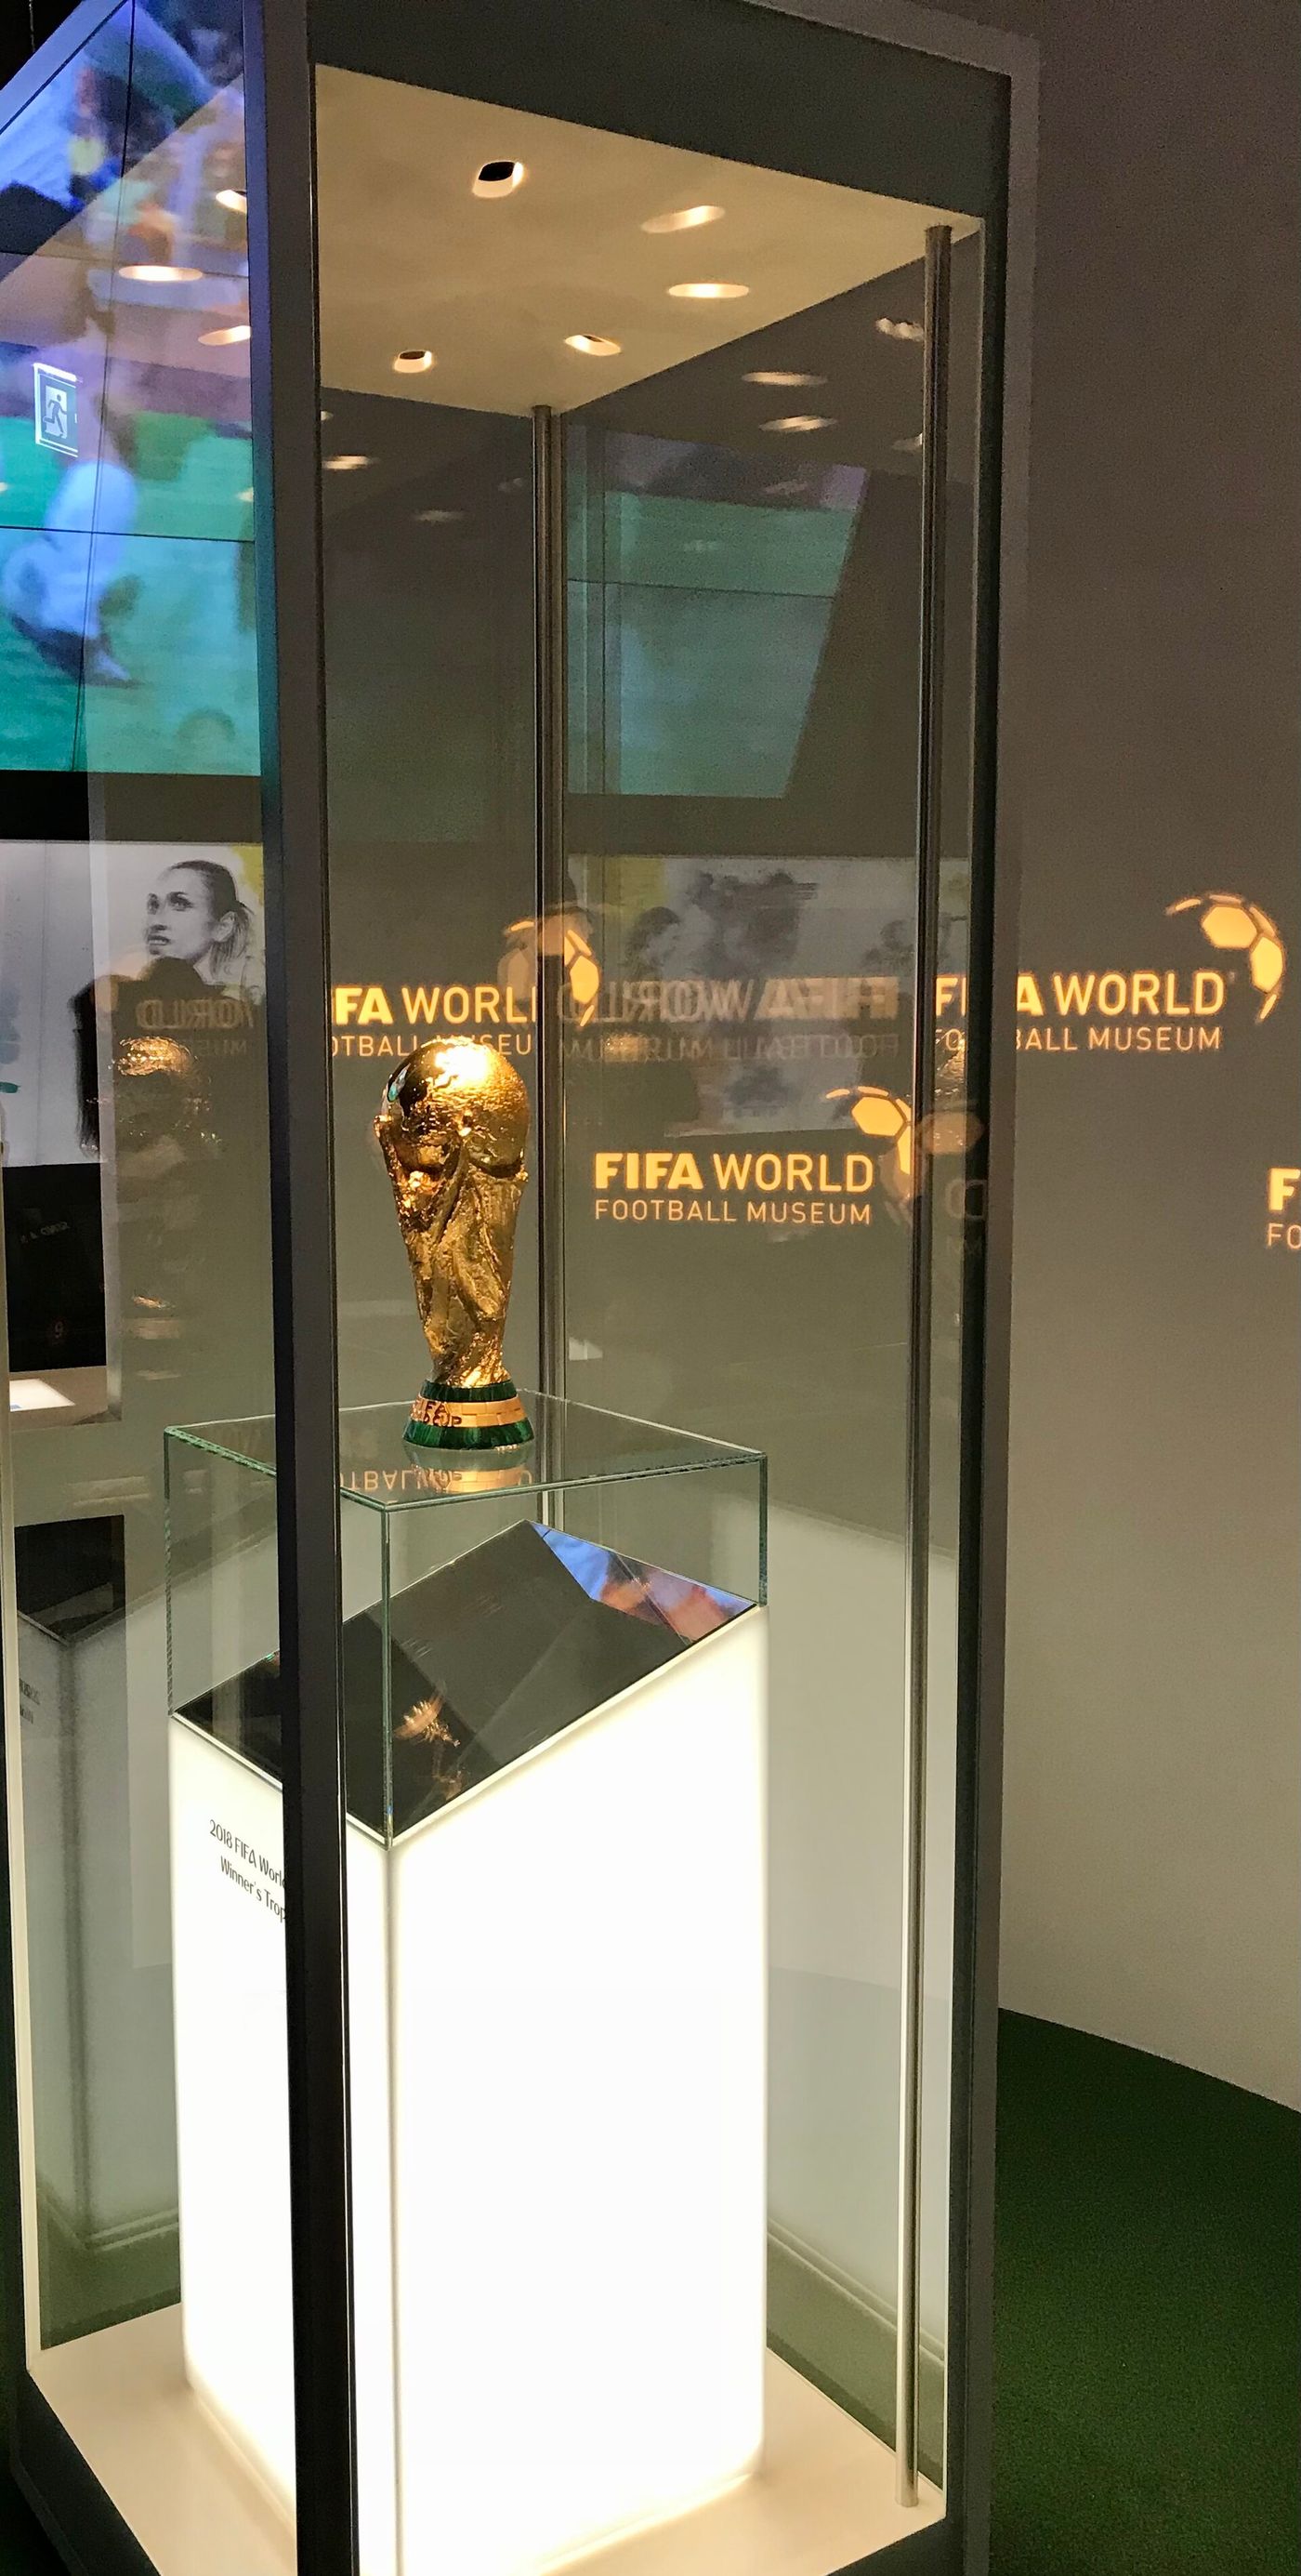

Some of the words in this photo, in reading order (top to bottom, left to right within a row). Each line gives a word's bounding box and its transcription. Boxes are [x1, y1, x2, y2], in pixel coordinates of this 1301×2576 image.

[401, 985, 537, 1024] WORL
[1053, 971, 1226, 1017] WORLD
[1087, 1025, 1222, 1051] MUSEUM
[594, 1152, 704, 1190] FIFA
[713, 1153, 874, 1194] WORLD
[595, 1198, 738, 1222] FOOTBALL
[746, 1202, 872, 1226] MUSEUM
[1267, 1222, 1301, 1249] FO
[209, 1818, 233, 1849] 2018
[234, 1836, 257, 1869] FIFA
[219, 1855, 262, 1902] Winner's
